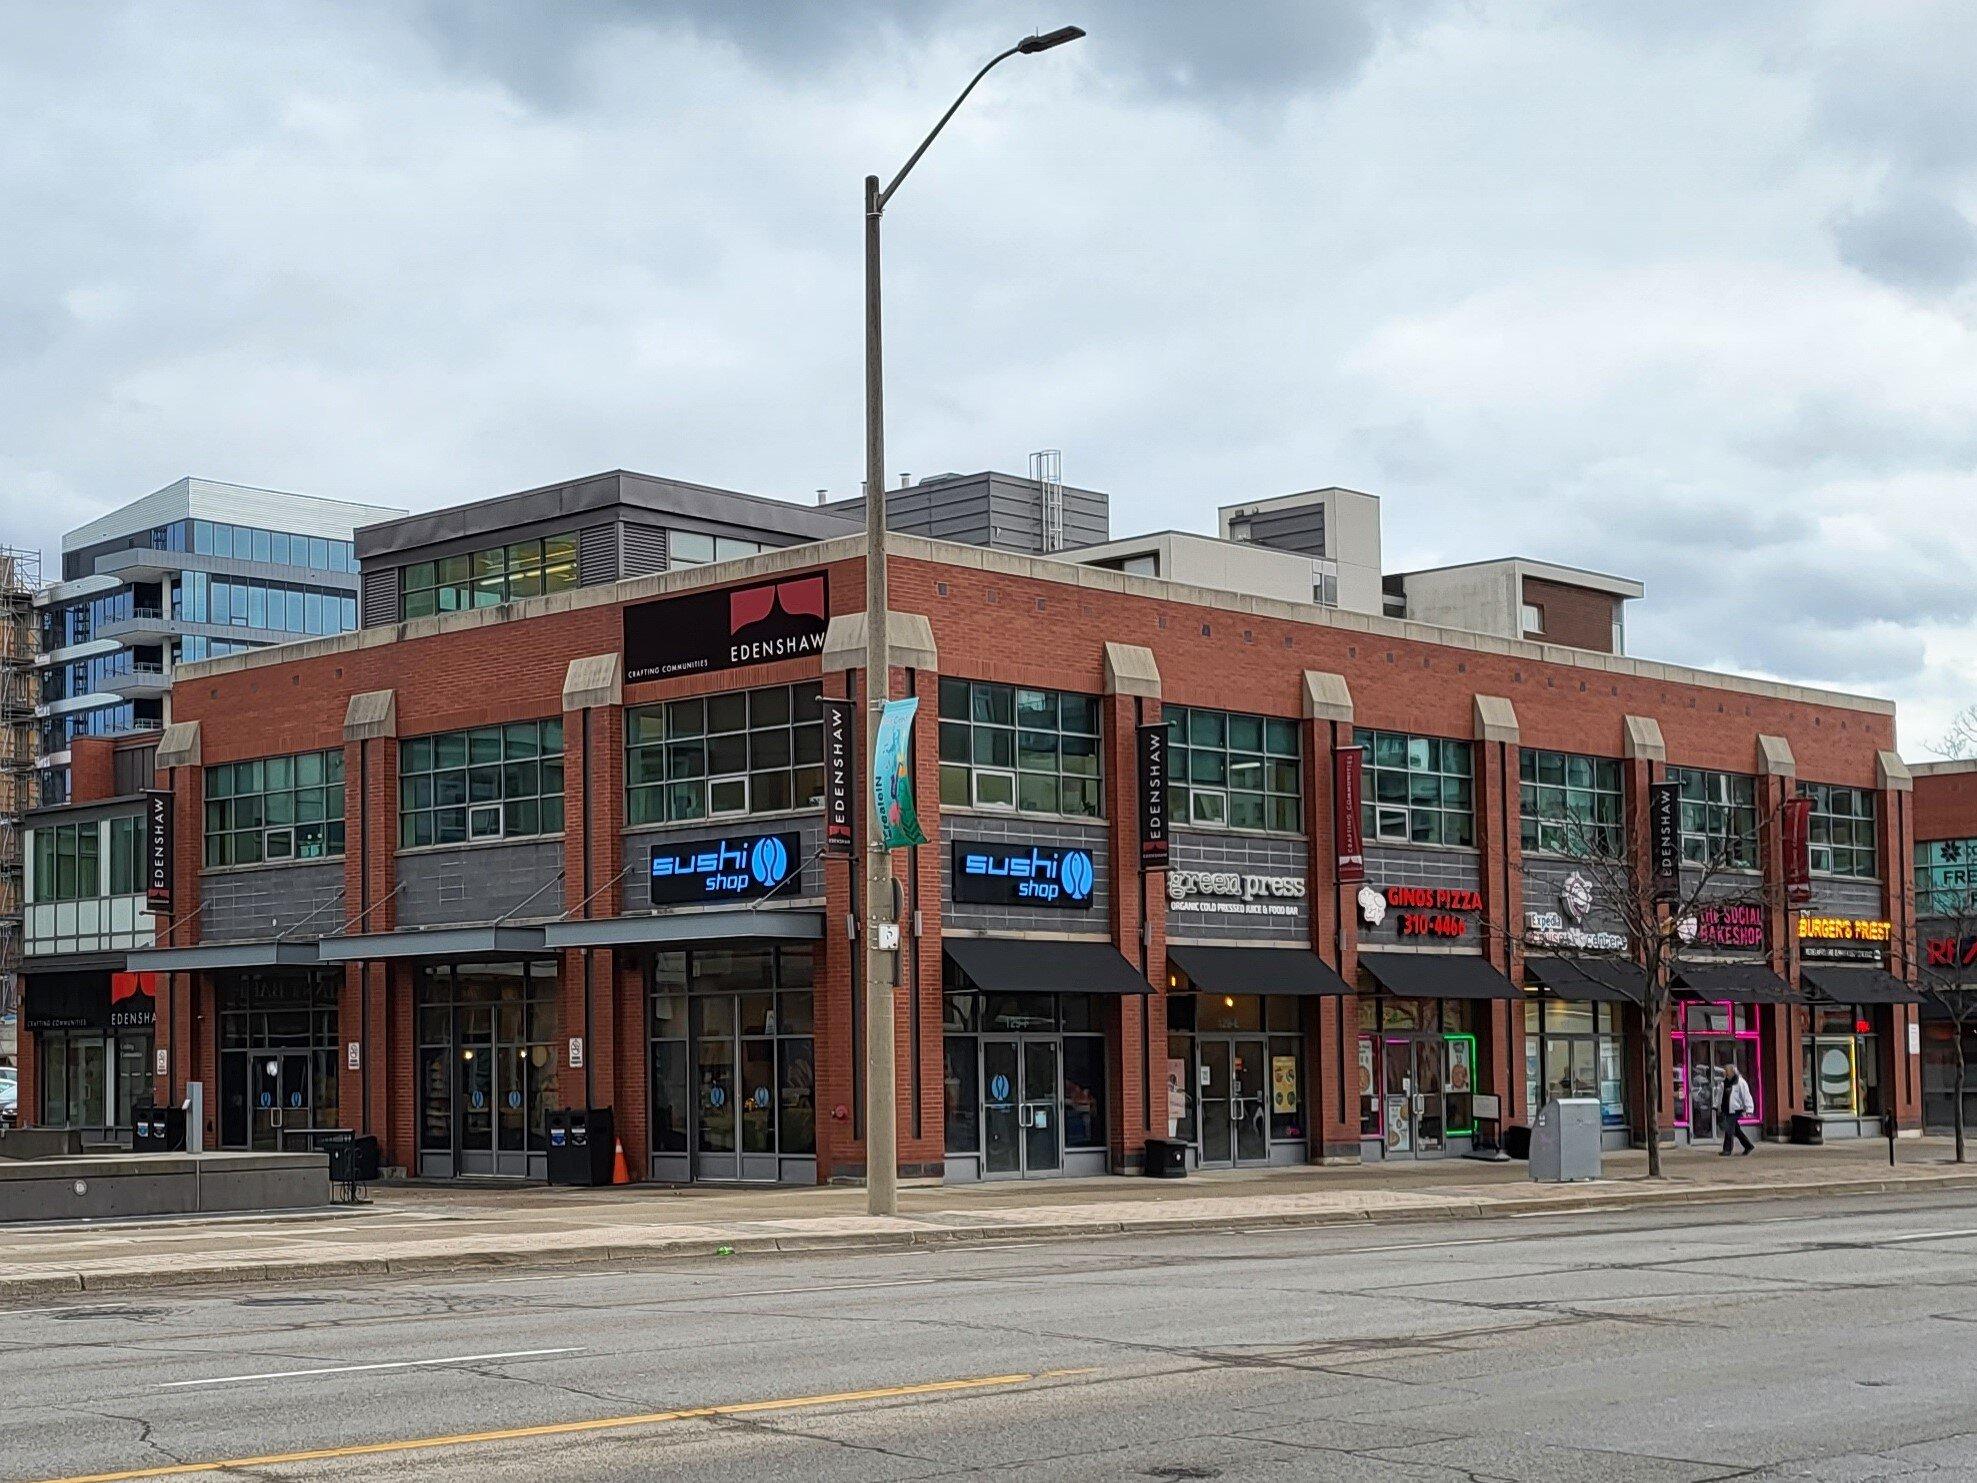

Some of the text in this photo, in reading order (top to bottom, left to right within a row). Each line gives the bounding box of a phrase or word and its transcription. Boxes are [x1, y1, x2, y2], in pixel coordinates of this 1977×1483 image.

[731, 632, 825, 662] EDENSHAW
[628, 659, 708, 679] CRAFTING COMMUNITIES
[831, 709, 845, 823] EDENSHAW
[1150, 734, 1160, 839] EDENSHAW
[154, 798, 164, 888] EDENSHAW
[1660, 790, 1672, 877] EDENSHAW
[653, 840, 748, 876] sushi
[965, 848, 1059, 879] sushi
[706, 873, 749, 892] shop
[1018, 879, 1059, 901] shop
[1167, 871, 1305, 901] green press
[1171, 902, 1199, 911] ORGANIC
[1200, 902, 1216, 912] COLD
[1218, 903, 1244, 913] PRESSED
[1269, 905, 1285, 915] FOOD
[1286, 906, 1298, 915] BAR
[1437, 888, 1482, 910] PIZZA
[1855, 920, 1891, 940] PRIEST
[111, 1012, 157, 1026] EDENSHA
